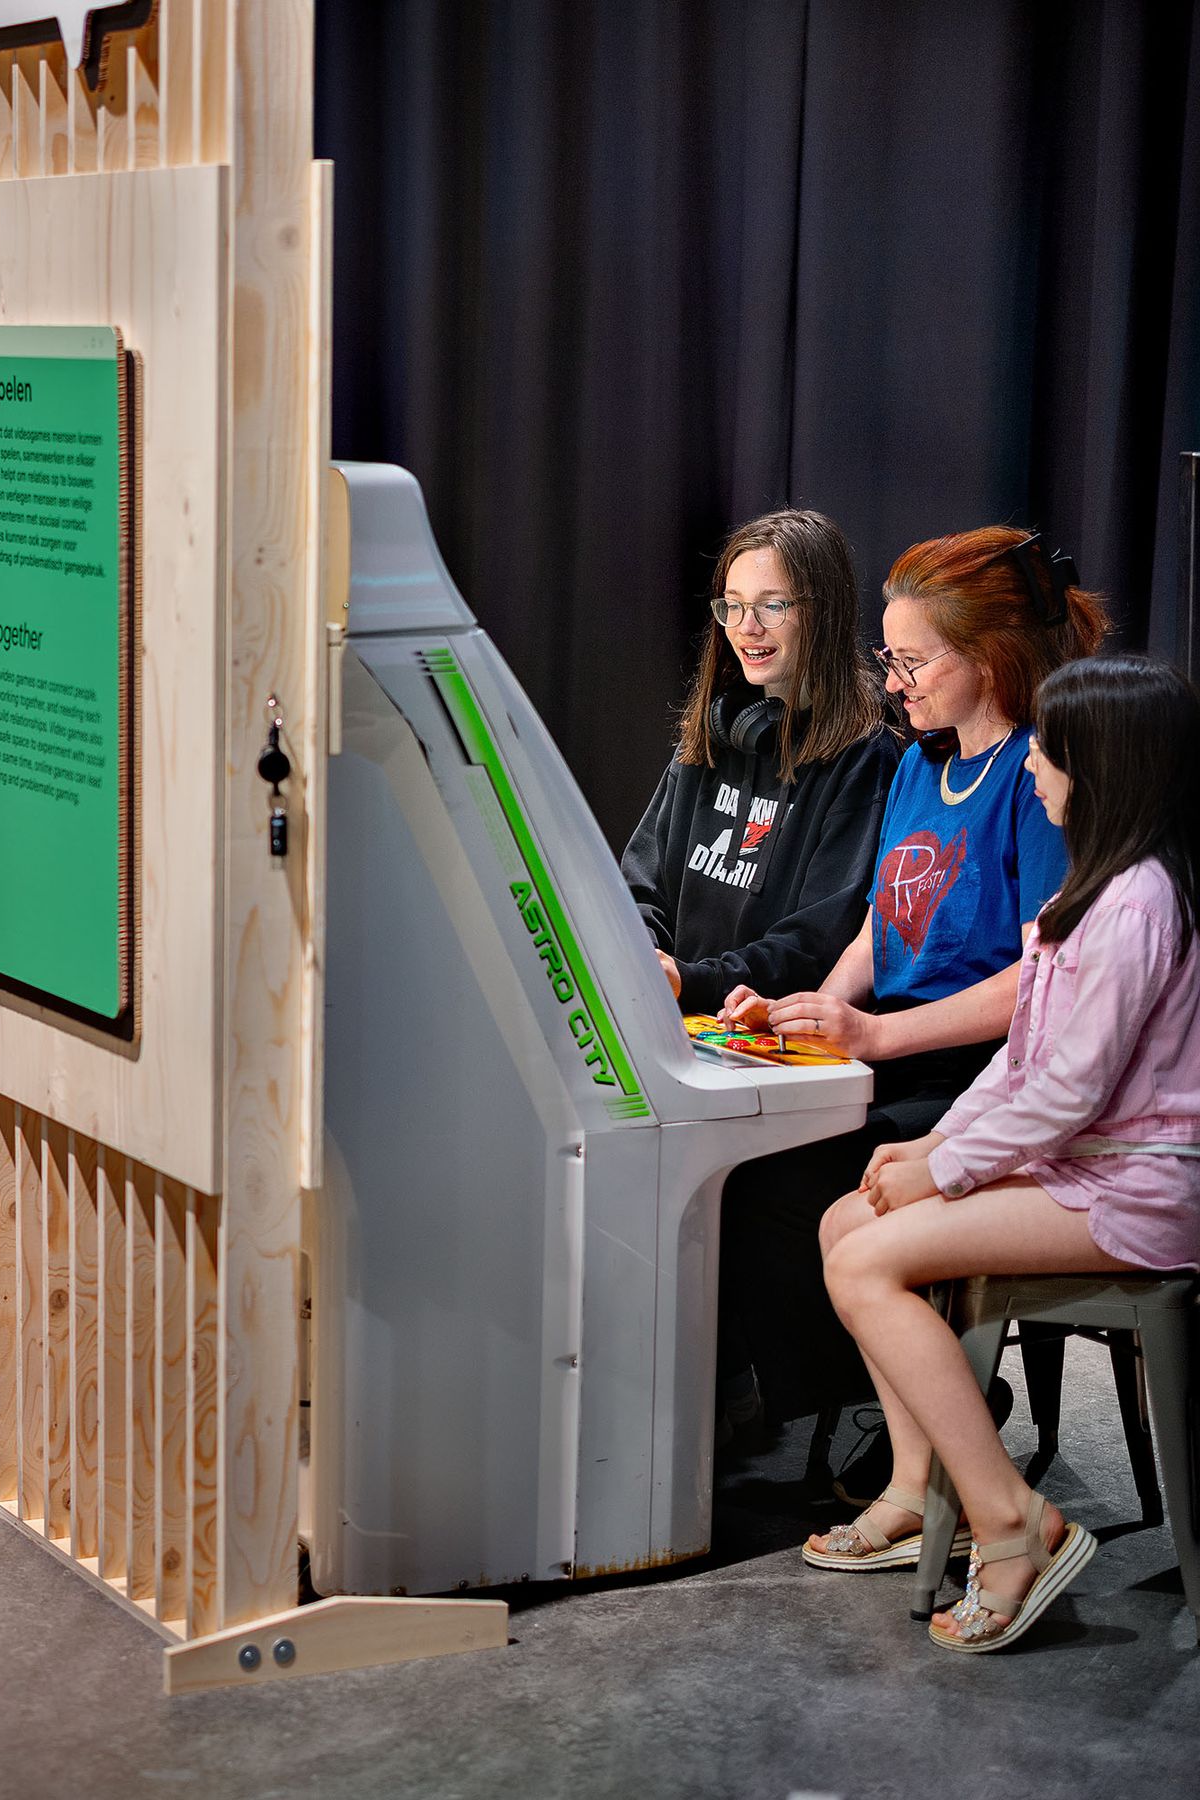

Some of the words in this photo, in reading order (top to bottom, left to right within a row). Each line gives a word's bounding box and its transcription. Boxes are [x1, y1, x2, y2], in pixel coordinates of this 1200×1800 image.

[714, 782, 794, 827] DAKN
[688, 843, 758, 889] DIARI
[509, 880, 575, 1004] ASTRO
[567, 1007, 616, 1087] CITY
